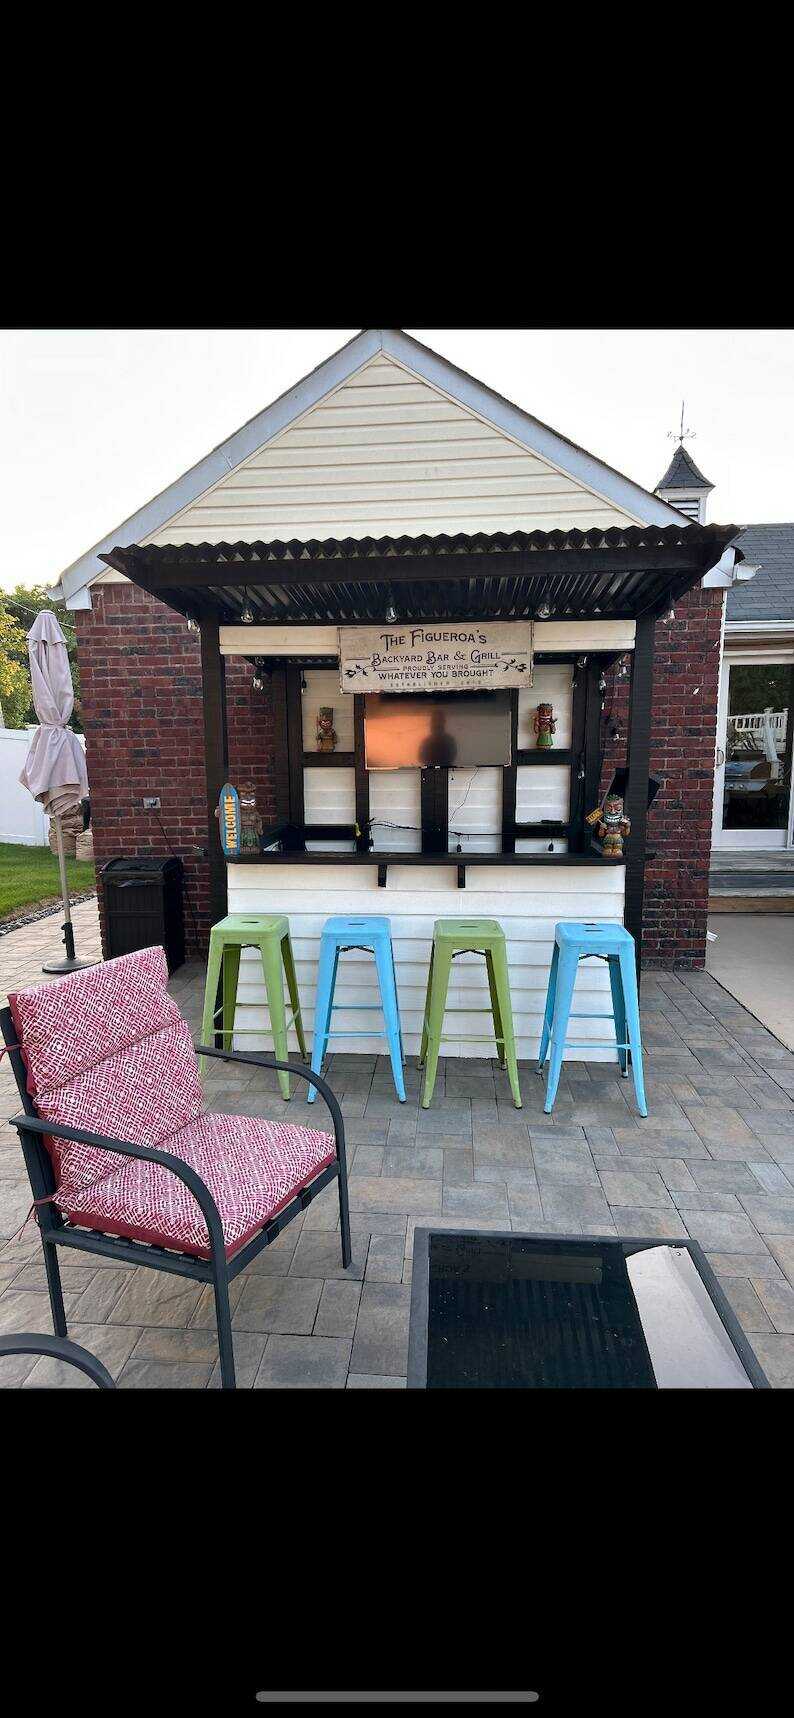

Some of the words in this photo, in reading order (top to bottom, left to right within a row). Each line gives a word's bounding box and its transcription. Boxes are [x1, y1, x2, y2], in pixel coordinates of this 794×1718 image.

[426, 650, 450, 665] BAR
[453, 651, 466, 661] &
[470, 650, 501, 664] GRILL
[378, 671, 427, 680] WHATEVER
[431, 670, 448, 678] YOU
[452, 669, 494, 677] BROUGHT
[224, 795, 237, 849] WELCOME
